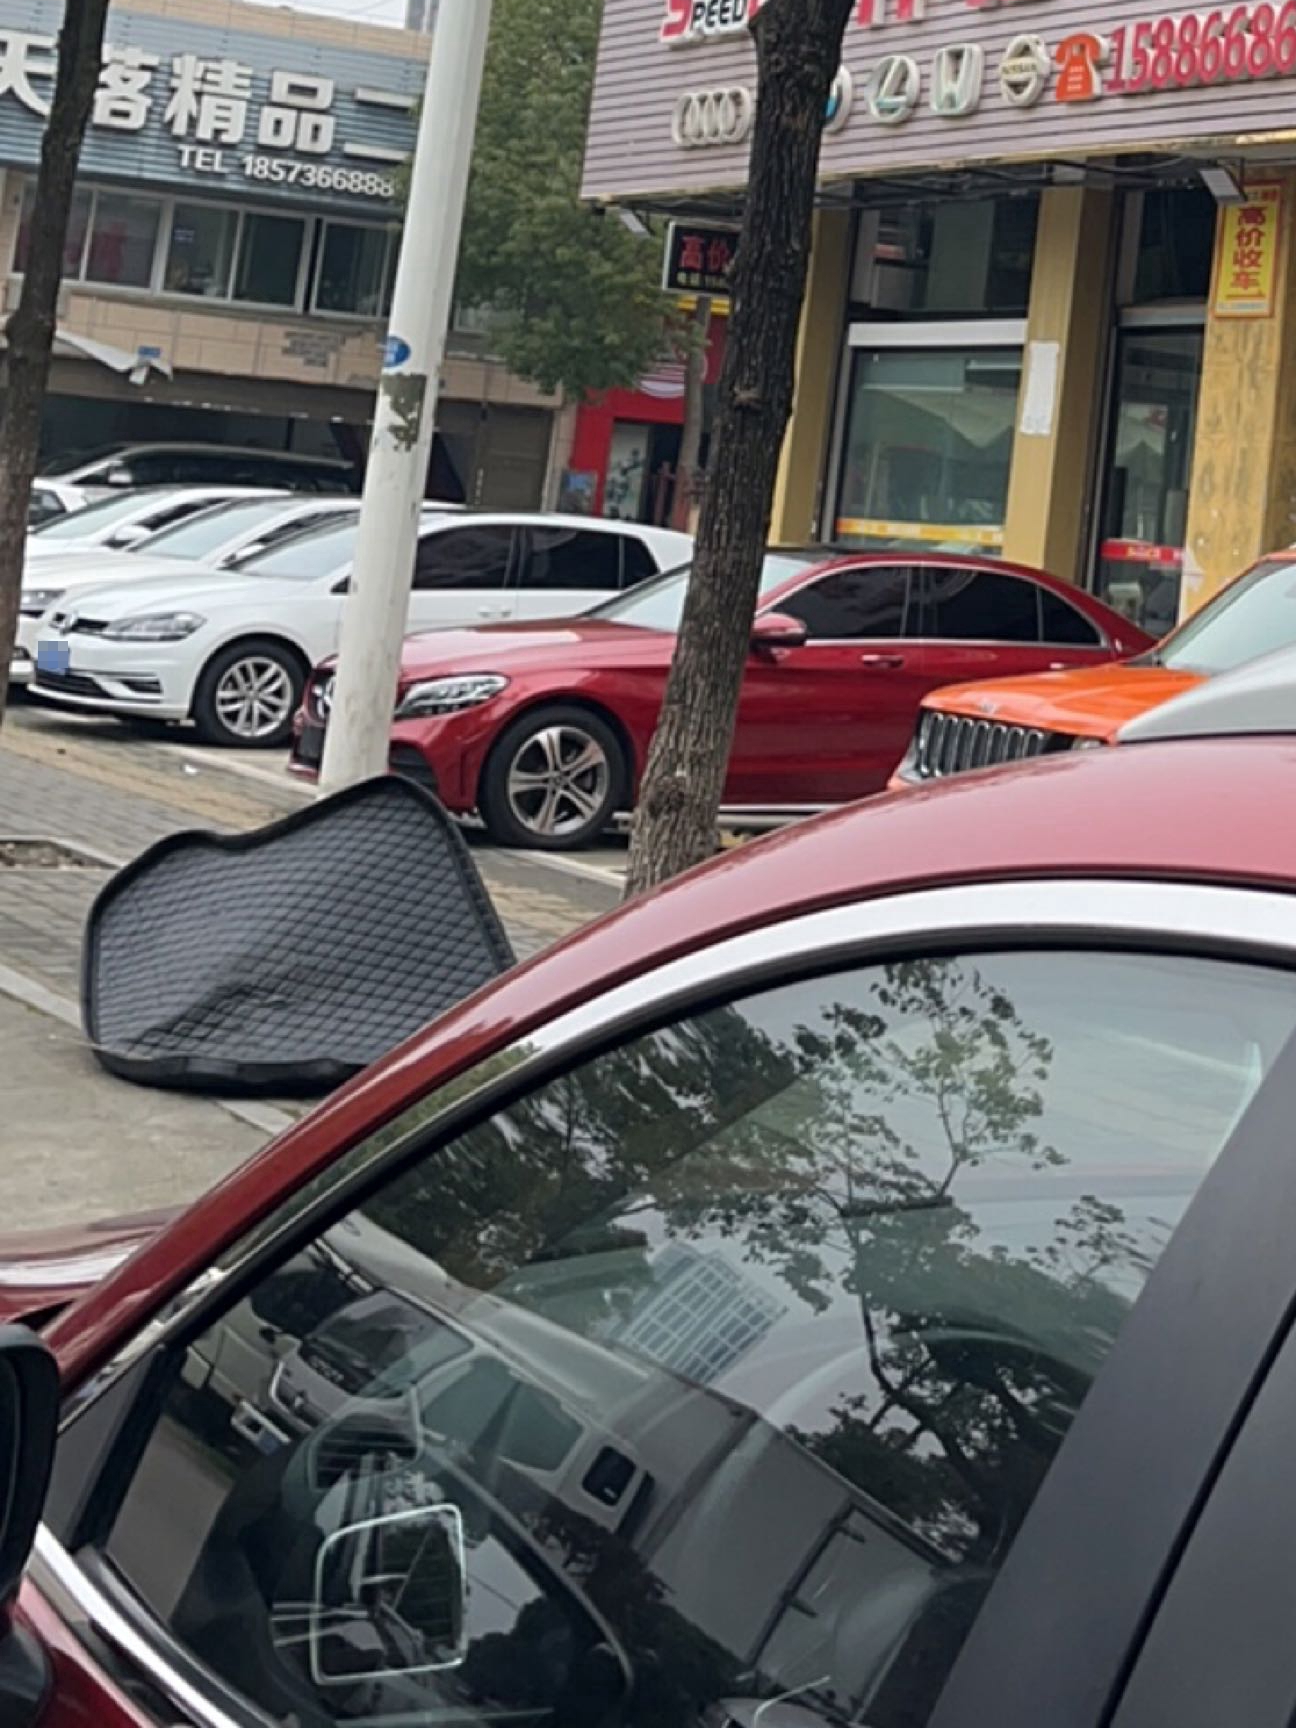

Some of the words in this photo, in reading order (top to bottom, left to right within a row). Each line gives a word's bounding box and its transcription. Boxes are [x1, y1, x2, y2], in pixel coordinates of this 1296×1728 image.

[178, 144, 229, 172] TEL
[1231, 207, 1267, 289] 高价收车
